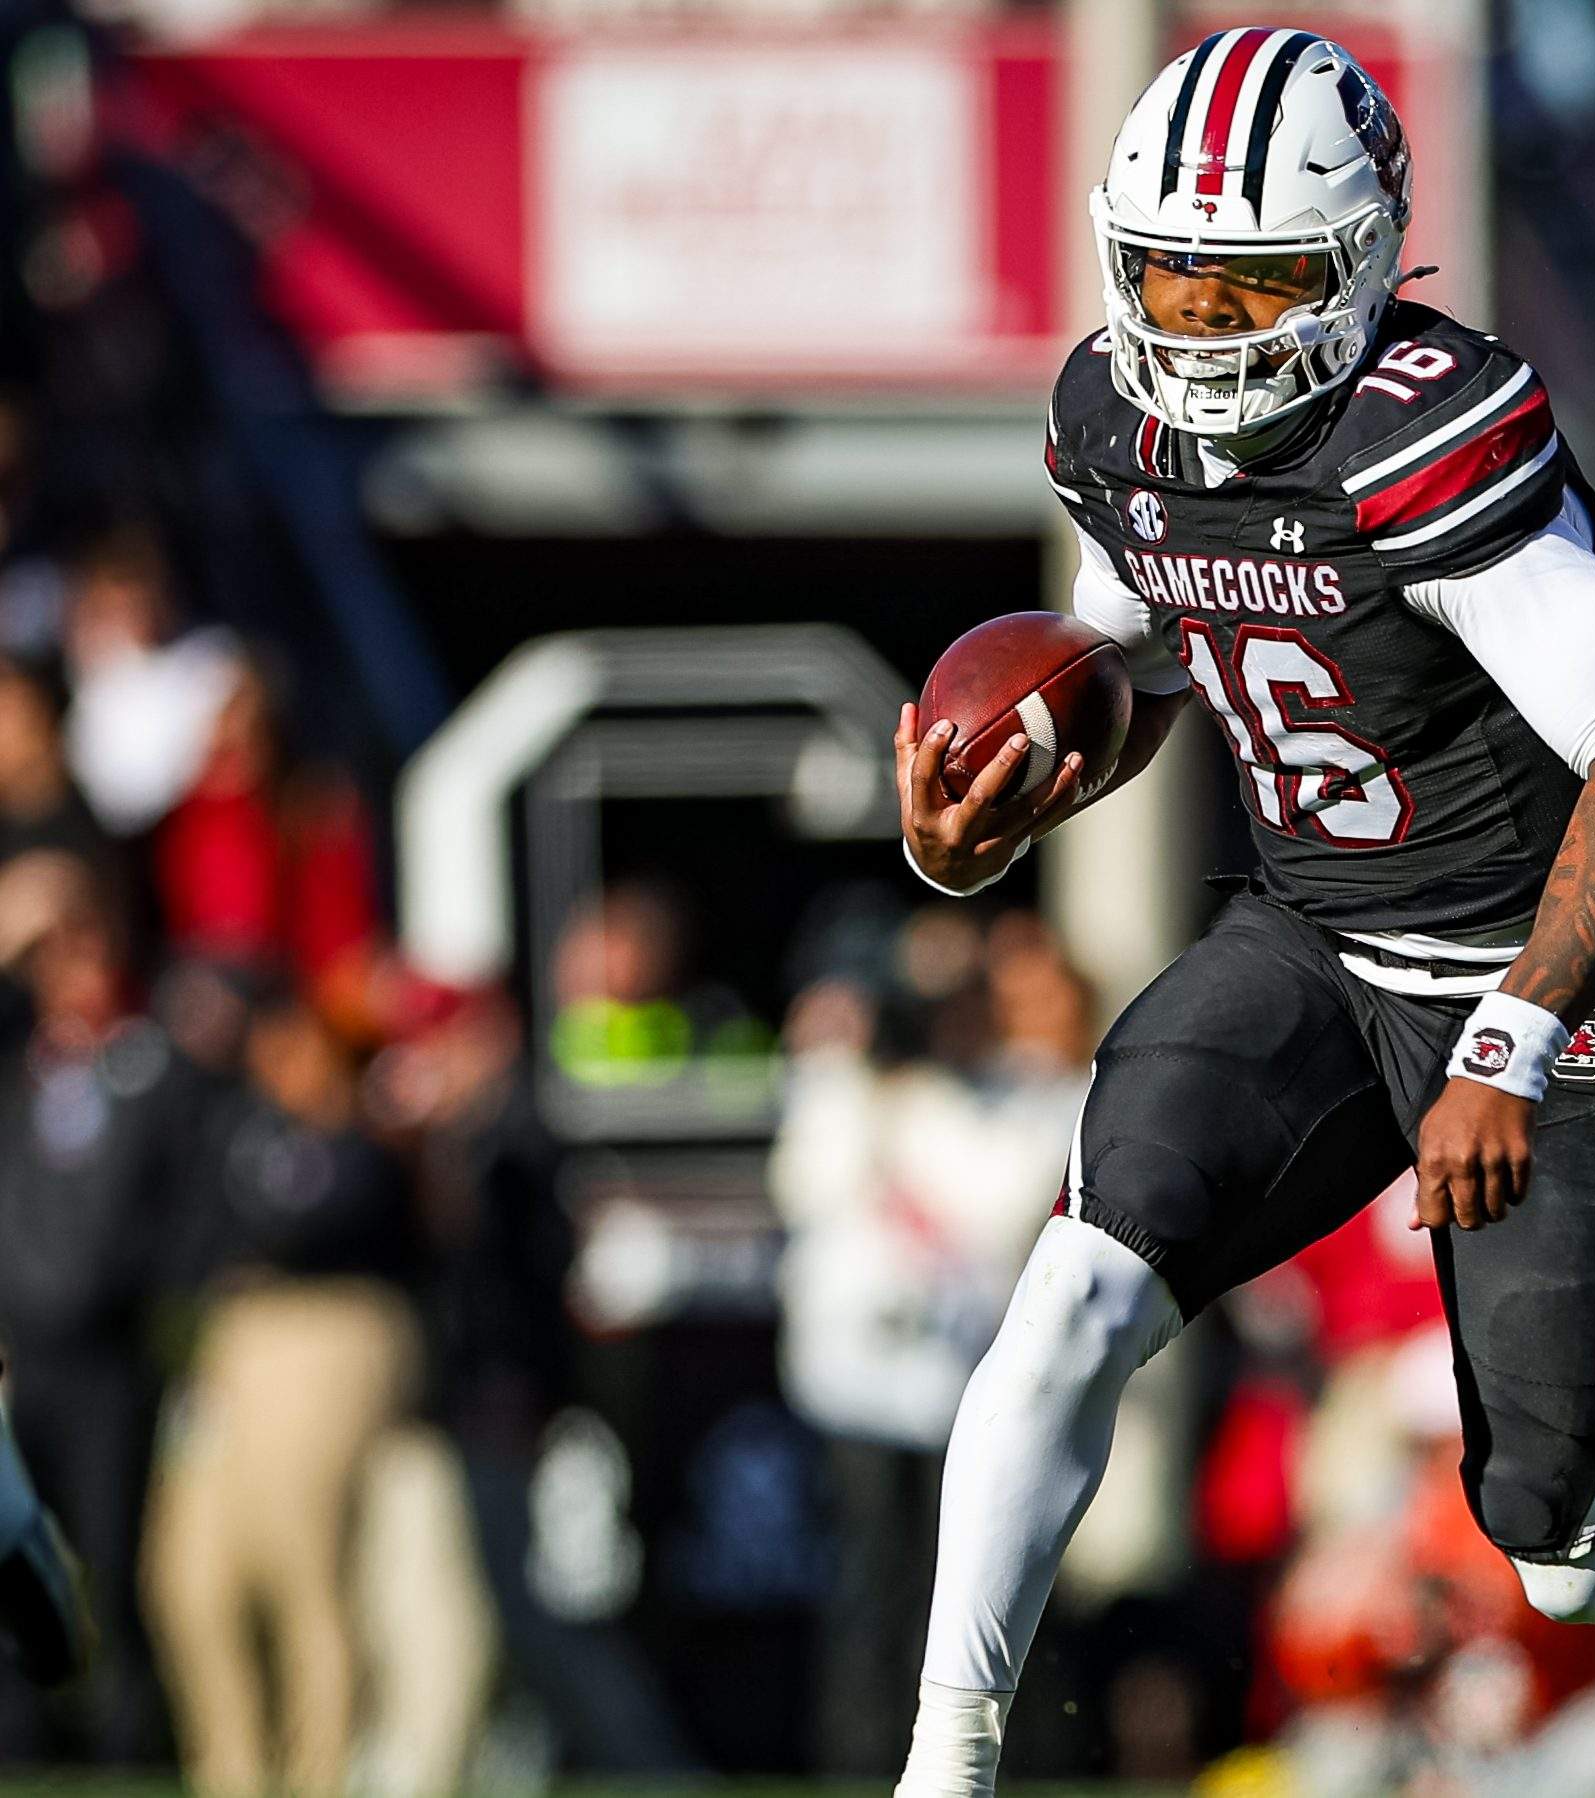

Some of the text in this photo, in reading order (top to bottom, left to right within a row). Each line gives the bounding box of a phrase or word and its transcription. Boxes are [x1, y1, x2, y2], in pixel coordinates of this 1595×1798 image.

[1189, 387, 1237, 400] Riddel
[1353, 339, 1458, 405] 16
[1128, 490, 1166, 541] SEC
[1124, 550, 1347, 616] GAMECOCKS
[1180, 617, 1416, 849] 16
